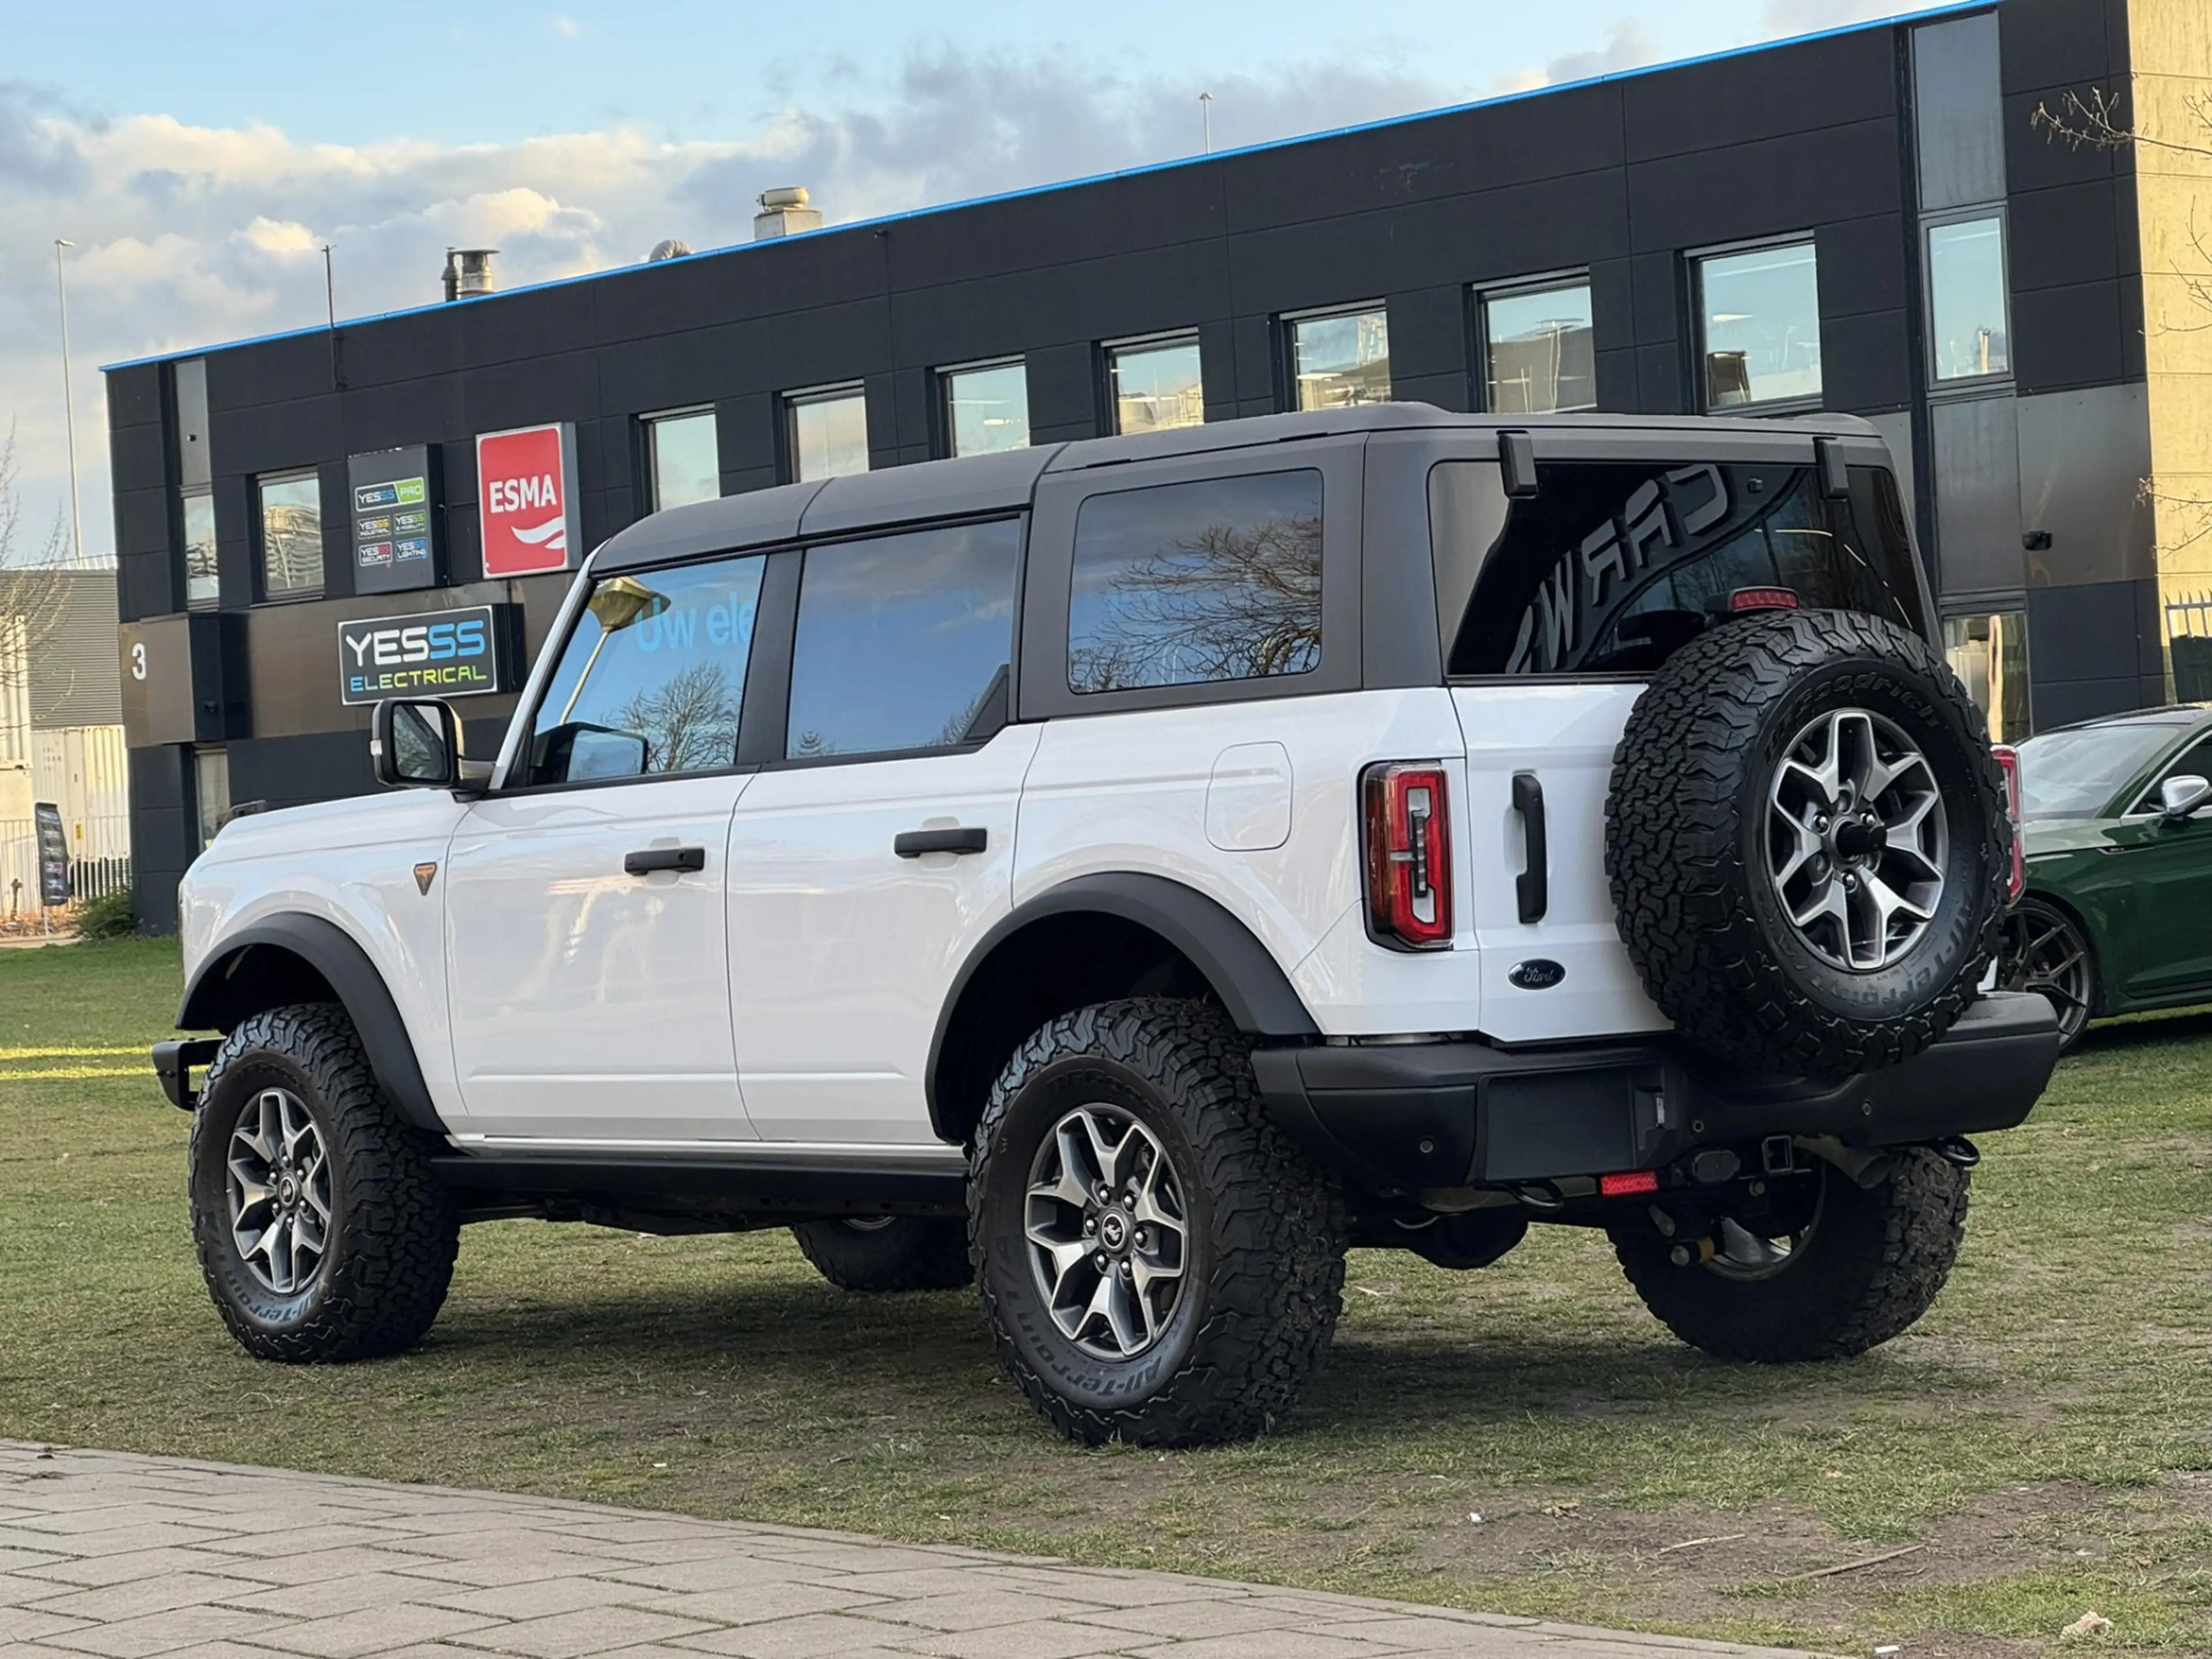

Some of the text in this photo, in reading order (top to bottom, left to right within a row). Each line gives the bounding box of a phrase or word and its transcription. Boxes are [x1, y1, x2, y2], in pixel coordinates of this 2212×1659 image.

[358, 485, 421, 504] YESSS PRO
[489, 474, 556, 513] ESMA
[346, 620, 484, 666] YESSS
[131, 642, 146, 680] 3
[350, 665, 487, 692] ELECTRICAL
[1524, 967, 1554, 983] Ford
